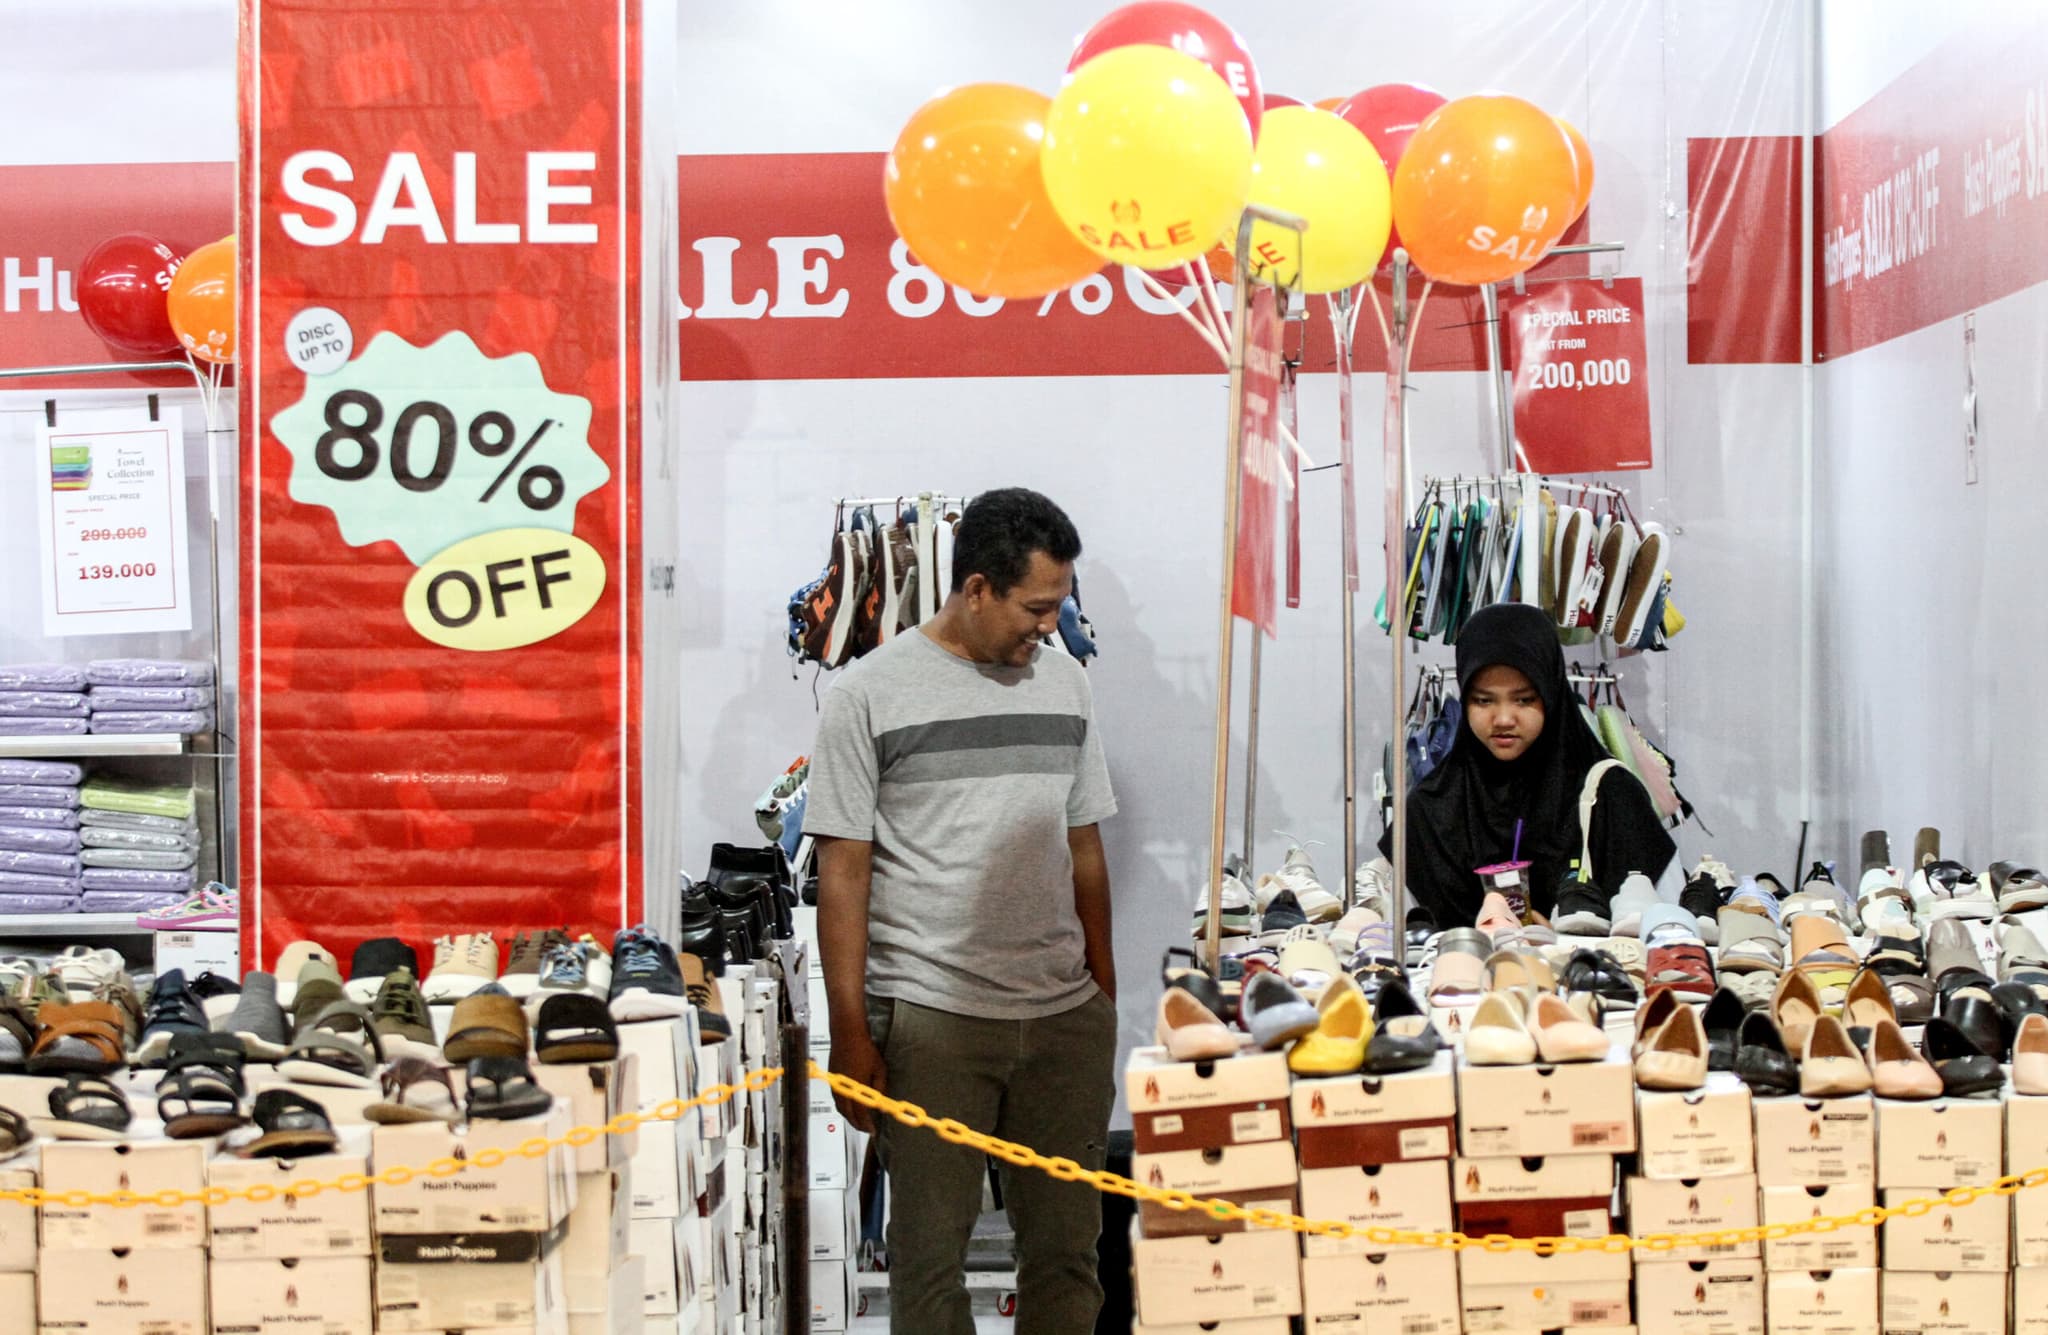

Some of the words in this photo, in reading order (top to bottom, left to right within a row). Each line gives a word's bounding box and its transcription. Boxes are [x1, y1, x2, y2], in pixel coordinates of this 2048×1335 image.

[280, 150, 598, 246] SALE
[1080, 220, 1196, 251] SALE
[1863, 176, 1892, 280] SALE
[1587, 307, 1631, 324] PRICE
[298, 323, 335, 343] DISC
[300, 346, 320, 363] UP
[325, 338, 344, 355] TO
[1558, 338, 1586, 351] FROM
[1528, 358, 1631, 391] 200,000
[117, 456, 145, 467] Towel
[107, 467, 155, 480] Collection
[80, 527, 148, 542] 299.000
[79, 562, 156, 580] 139.000
[426, 549, 572, 628] OFF
[480, 773, 509, 785] Apply
[423, 1180, 450, 1190] Hush
[454, 1180, 498, 1192] Puppies
[418, 1246, 450, 1258] Hush
[452, 1246, 497, 1260] Puppies
